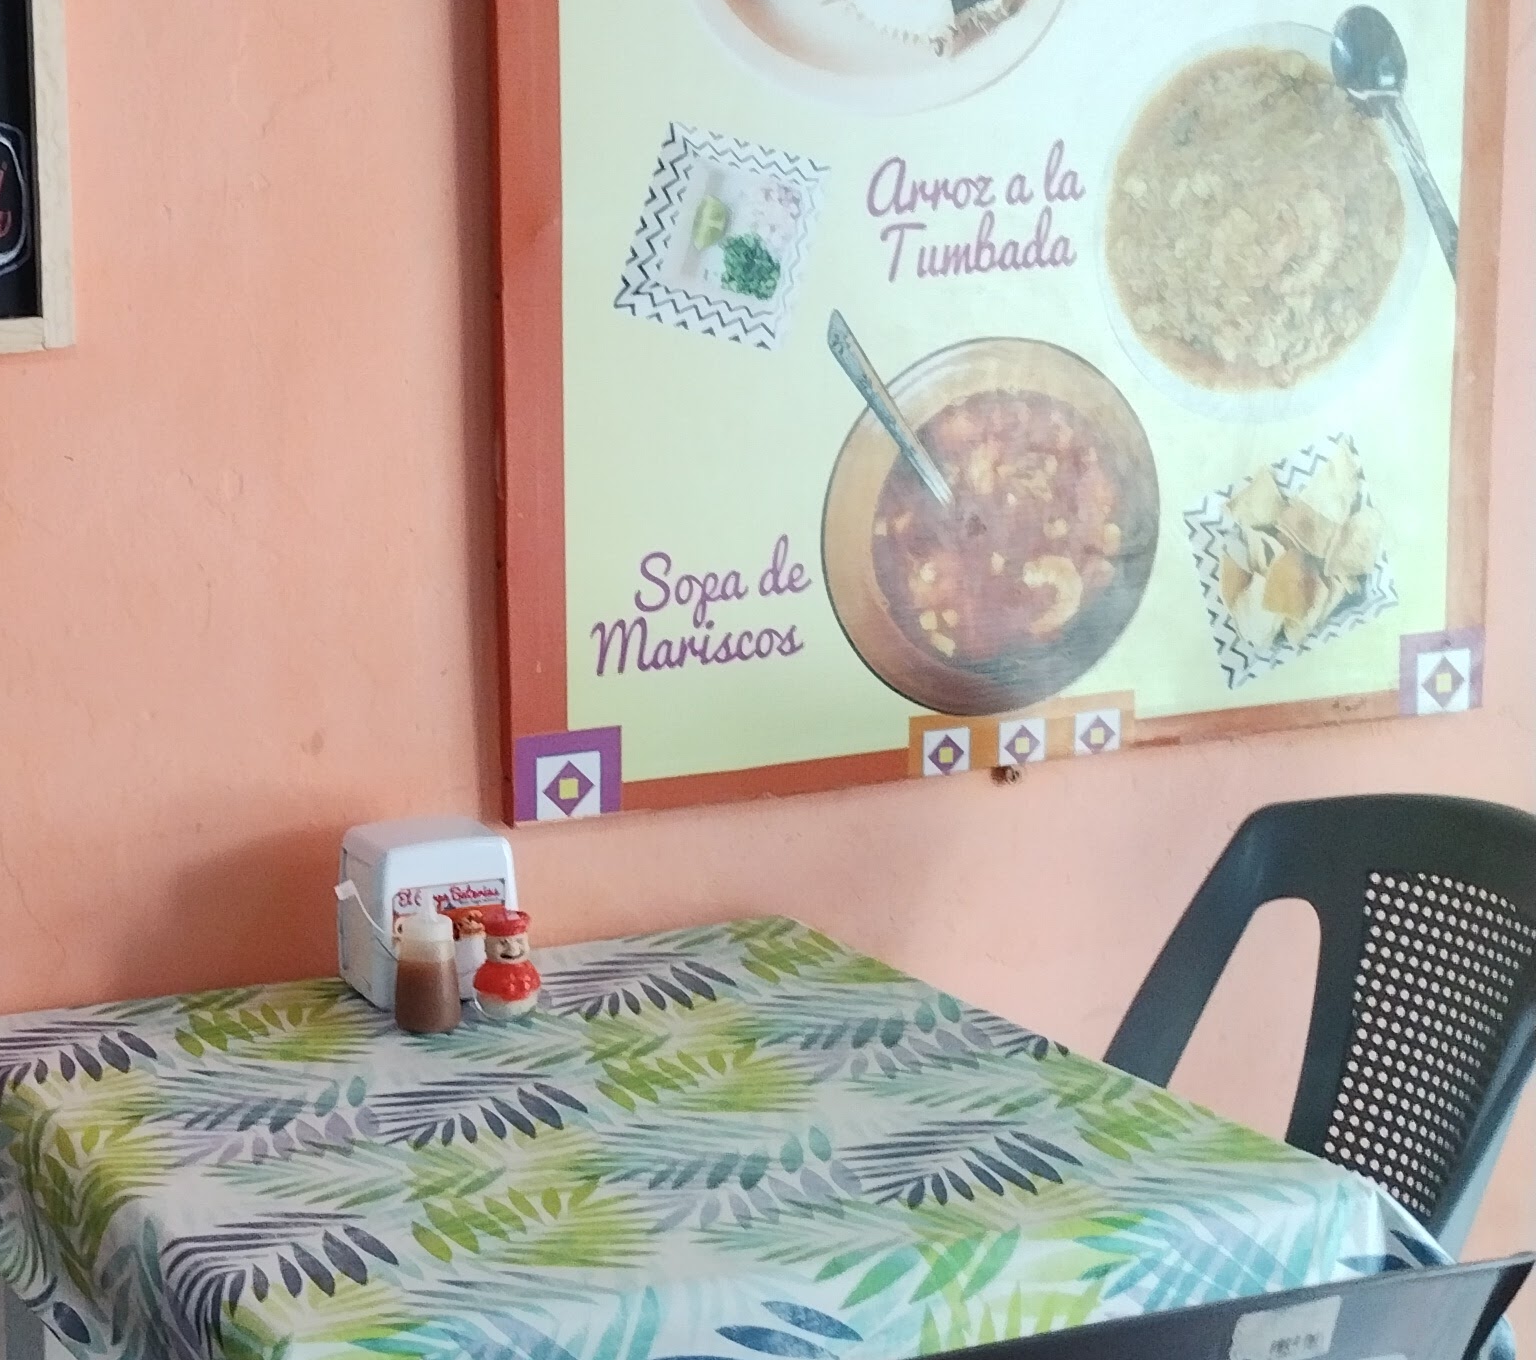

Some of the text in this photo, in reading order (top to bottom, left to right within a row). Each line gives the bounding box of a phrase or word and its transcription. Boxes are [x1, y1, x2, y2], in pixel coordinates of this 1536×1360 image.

[866, 139, 1086, 218] Arroz a la
[879, 206, 1078, 283] Tumbada
[634, 534, 813, 629] Sopa de
[590, 616, 805, 677] Mariscos
